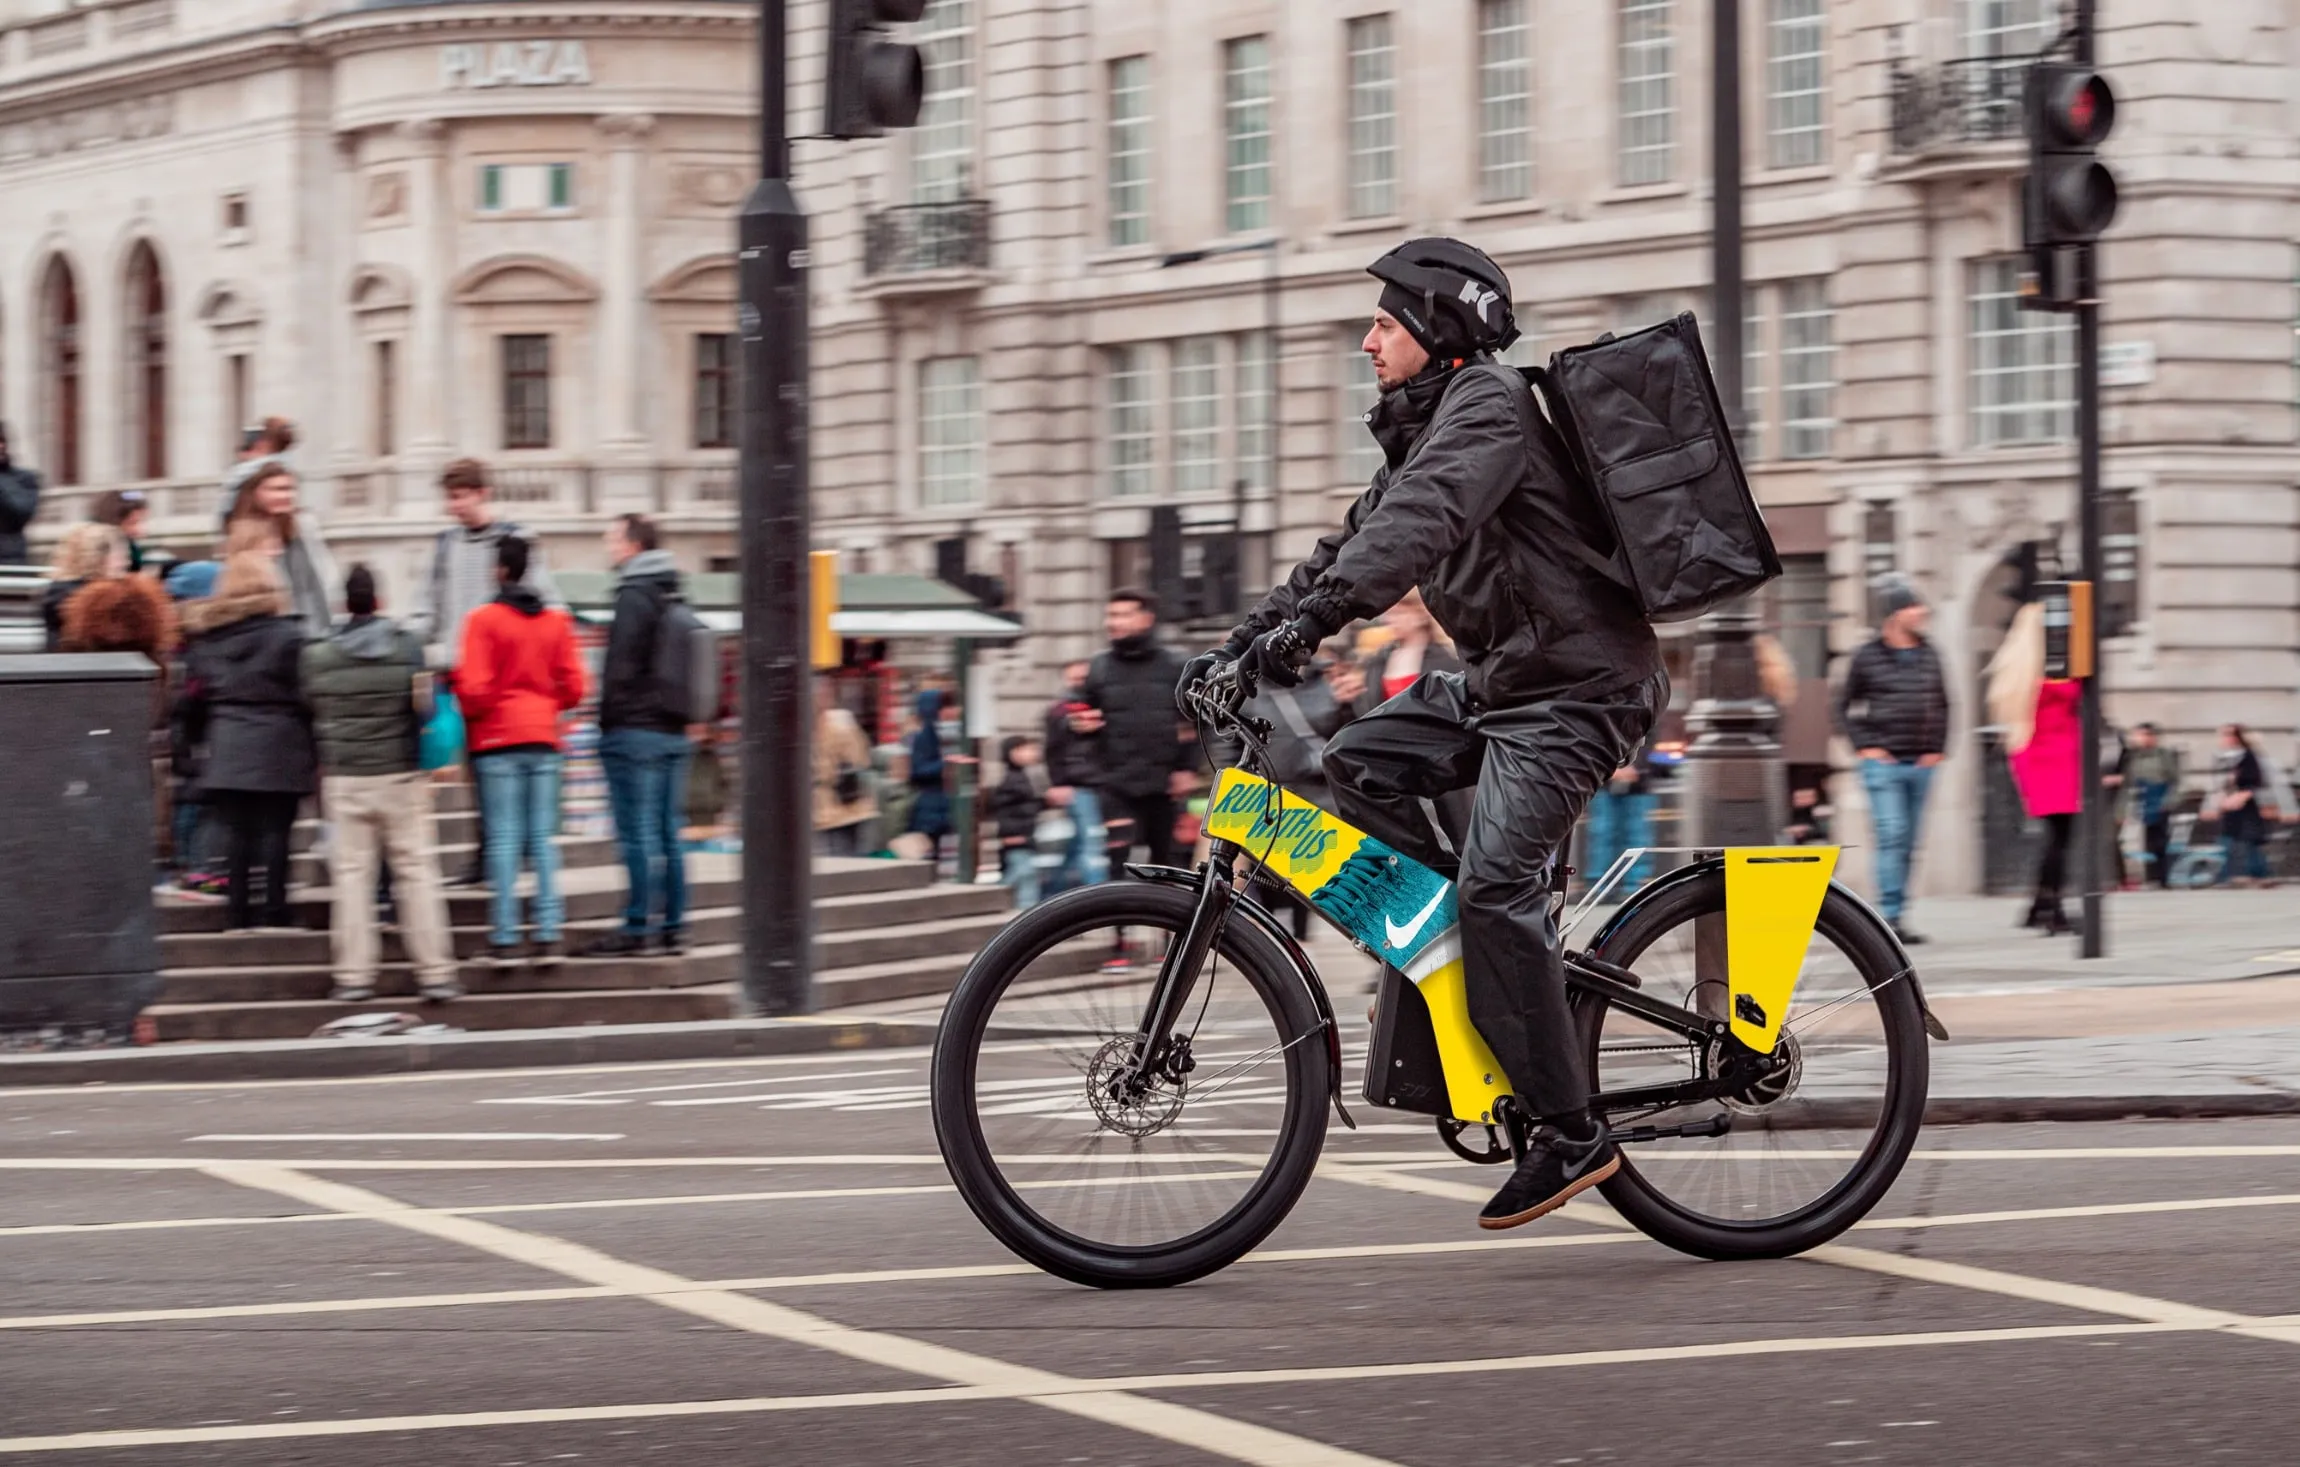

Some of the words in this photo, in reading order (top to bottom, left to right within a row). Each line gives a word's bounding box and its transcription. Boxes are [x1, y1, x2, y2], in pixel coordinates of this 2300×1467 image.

[437, 40, 592, 87] PLAZA
[1213, 783, 1278, 813] RUN
[1246, 808, 1322, 838] WITH
[1290, 829, 1338, 860] US
